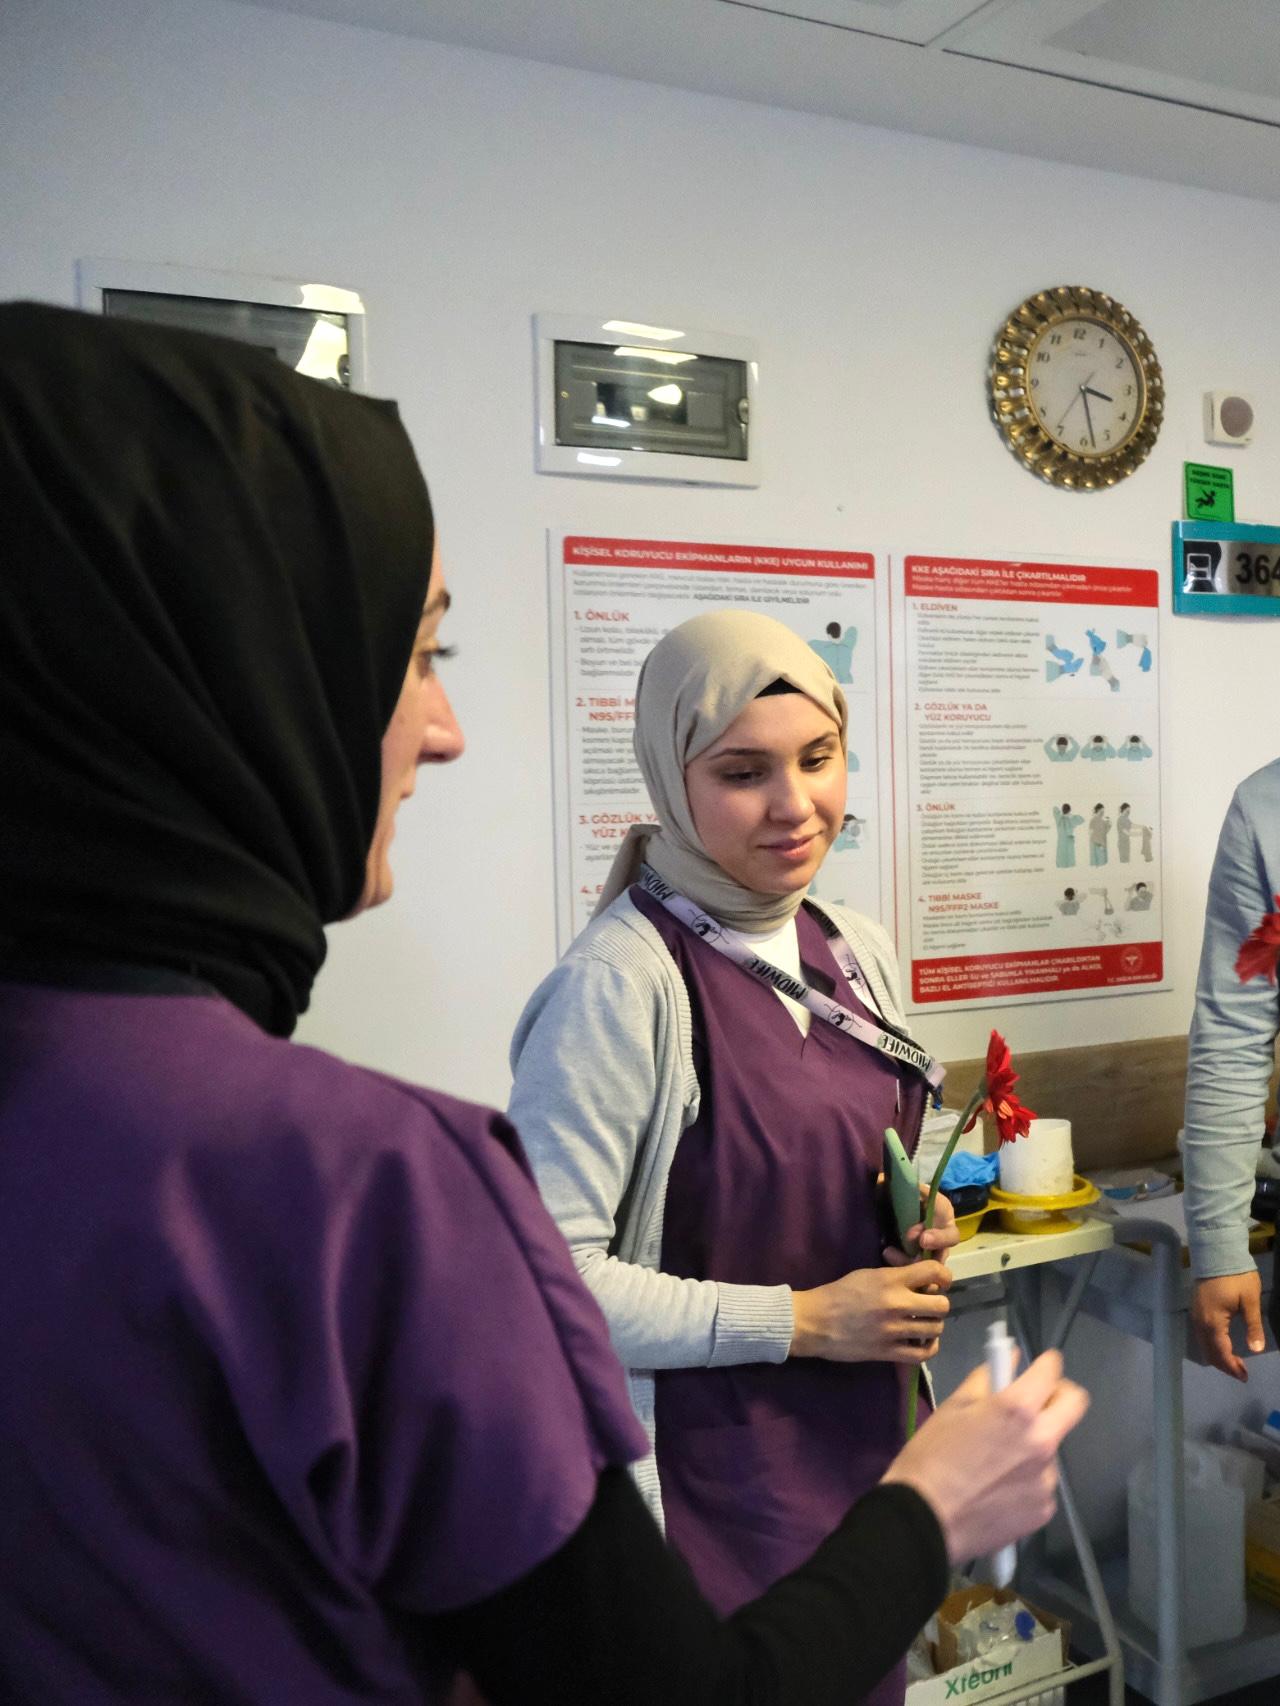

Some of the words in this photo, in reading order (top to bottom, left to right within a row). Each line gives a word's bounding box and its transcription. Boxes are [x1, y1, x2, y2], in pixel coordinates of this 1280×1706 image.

[1050, 334, 1062, 345] 11
[1073, 328, 1086, 340] 12
[1098, 338, 1105, 349] 1
[1036, 351, 1050, 363] 10
[1115, 358, 1124, 369] 2
[1031, 377, 1039, 388] 9
[1124, 384, 1132, 396] 3
[1118, 411, 1127, 421] 4
[1057, 425, 1064, 436] 7
[1104, 429, 1111, 441] 5
[1079, 436, 1088, 447] 6
[573, 546, 612, 557] KİŞİSEL
[614, 549, 674, 560] KORUYUCU
[675, 550, 752, 564] EKİPMANLARIN
[754, 557, 780, 567] (KKE)
[782, 558, 815, 568] UYGUN
[817, 560, 868, 570] KULLANIMI
[911, 565, 930, 574] KKE
[931, 566, 979, 576] AŞAĞIDAKİ
[981, 568, 999, 577] SIRA
[1001, 568, 1015, 578] İLE
[1016, 570, 1087, 582] ÇIKARTILMALIDIR
[920, 602, 958, 611] ELDİVEN
[574, 610, 582, 620] 1.
[585, 608, 630, 621] ÖNLÜK
[576, 697, 586, 707] 2.
[588, 695, 621, 707] TIBBİ
[924, 702, 959, 711] GÖZLÜK
[962, 703, 973, 711] YA
[974, 703, 987, 711] DA
[925, 712, 941, 721] YÜZ
[943, 713, 991, 721] KORUYUCU
[925, 802, 955, 811] ÖNLÜK
[579, 815, 589, 824] 3.
[591, 812, 642, 824] GÖZLÜK
[592, 826, 617, 838] YÜZ
[581, 885, 592, 894] 4.
[928, 893, 951, 902] TIBBİ
[953, 892, 982, 901] MASKE
[928, 903, 968, 912] N95/FFP2
[970, 901, 999, 910] MASKE
[919, 967, 935, 976] TÜM
[964, 962, 1004, 972] KORUYUCU
[919, 976, 945, 985] SONRA
[946, 974, 968, 983] ELLER
[1081, 963, 1102, 971] ALKOL
[750, 959, 807, 1000] MIDWIFE
[919, 985, 940, 994] BAZLI
[942, 984, 951, 992] EL
[881, 1034, 931, 1072] MIDWIFE
